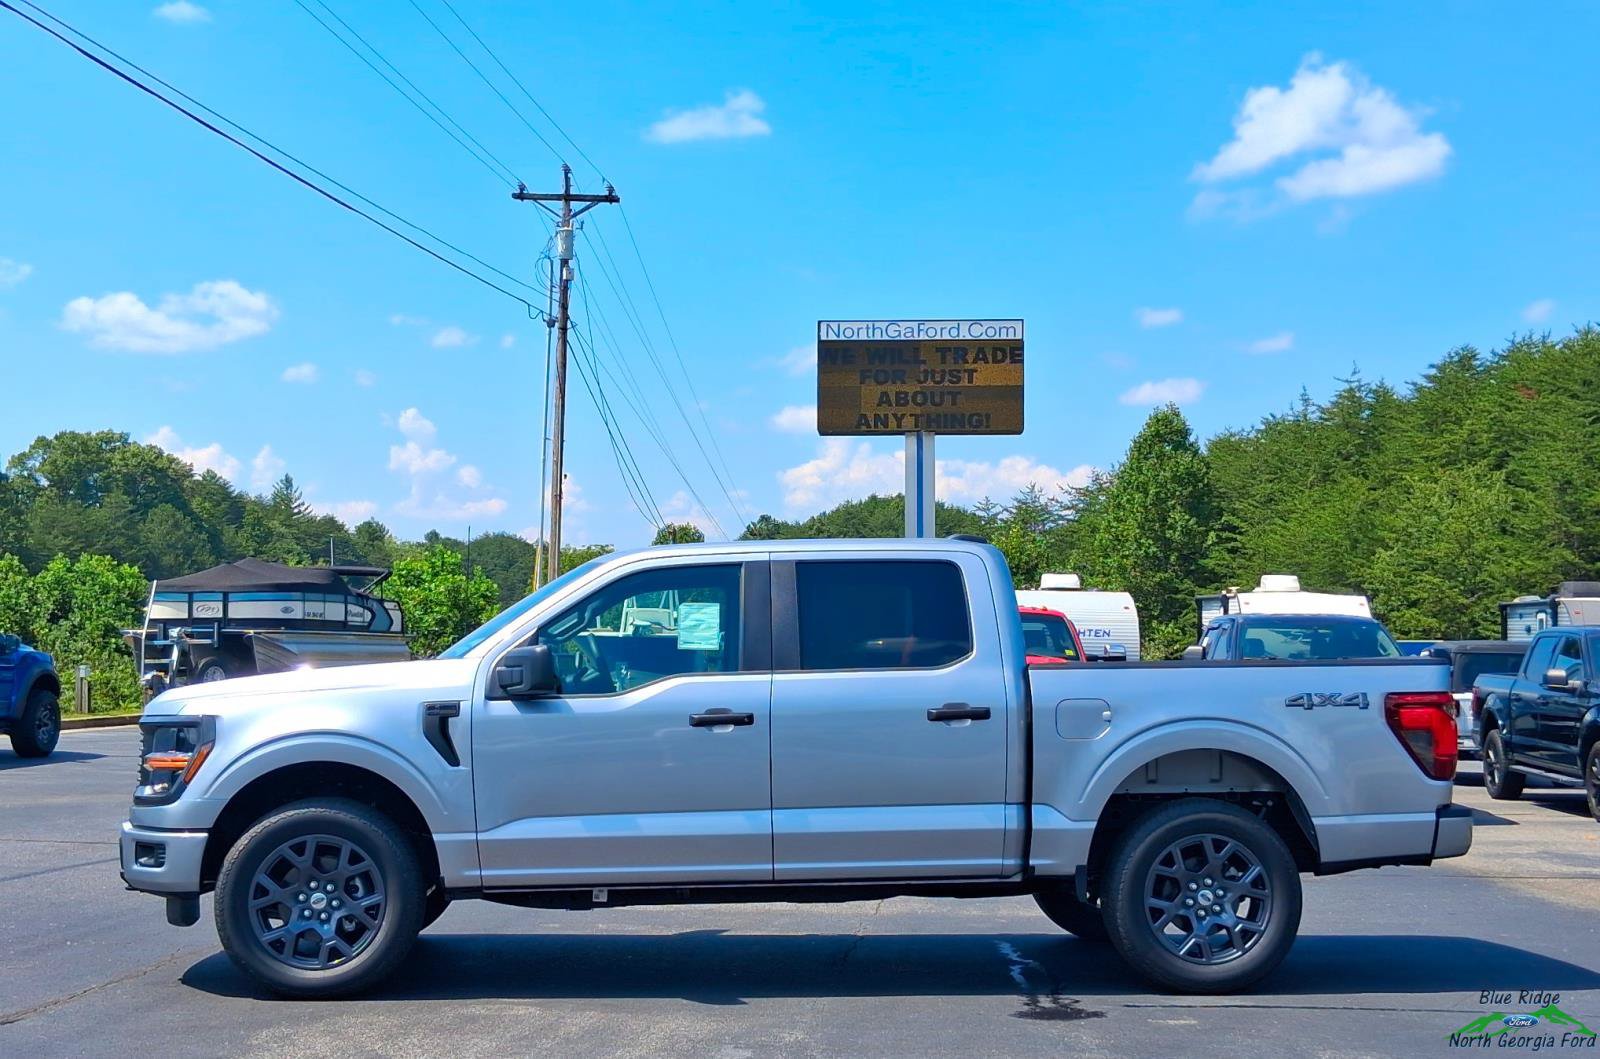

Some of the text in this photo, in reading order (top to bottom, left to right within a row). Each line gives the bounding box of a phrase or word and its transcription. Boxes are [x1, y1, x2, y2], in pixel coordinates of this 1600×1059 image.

[825, 322, 1017, 339] NorthGaFord.Com
[820, 347, 1023, 364] WE WILL TRADE
[859, 368, 978, 385] FOR JUST
[876, 390, 962, 407] ABOUT
[855, 412, 992, 430] ANYTHING!
